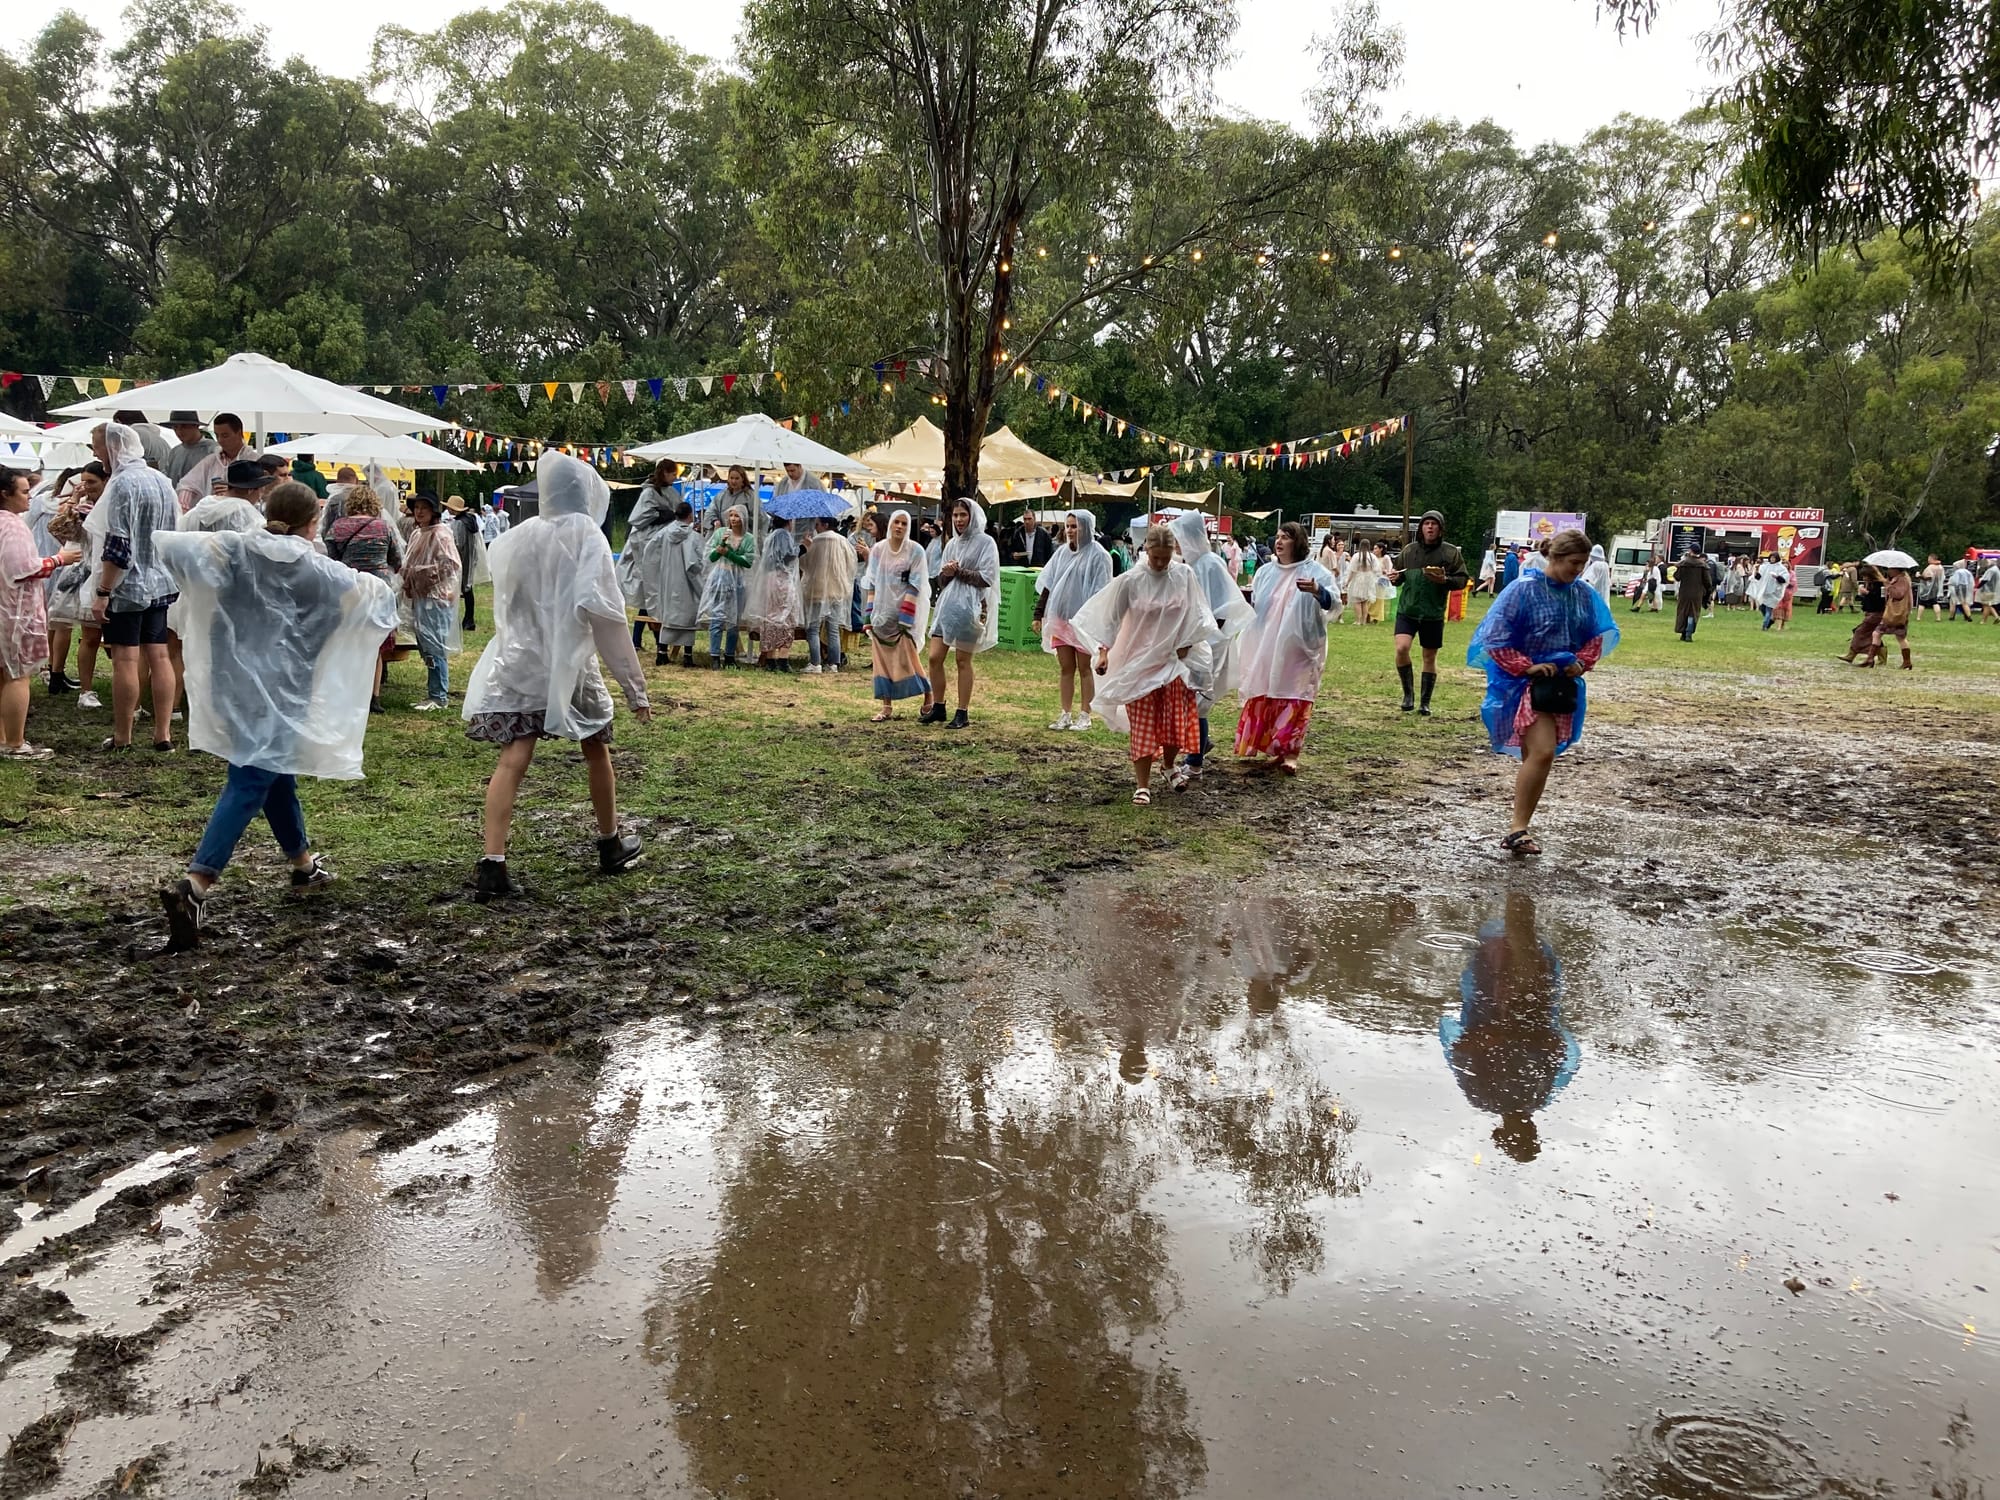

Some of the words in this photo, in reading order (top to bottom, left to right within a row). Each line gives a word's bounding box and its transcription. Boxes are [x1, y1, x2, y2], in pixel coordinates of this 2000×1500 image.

[1720, 508, 1759, 518] LOADED
[1763, 509, 1785, 519] HOT
[1789, 510, 1820, 520] CHIPS!
